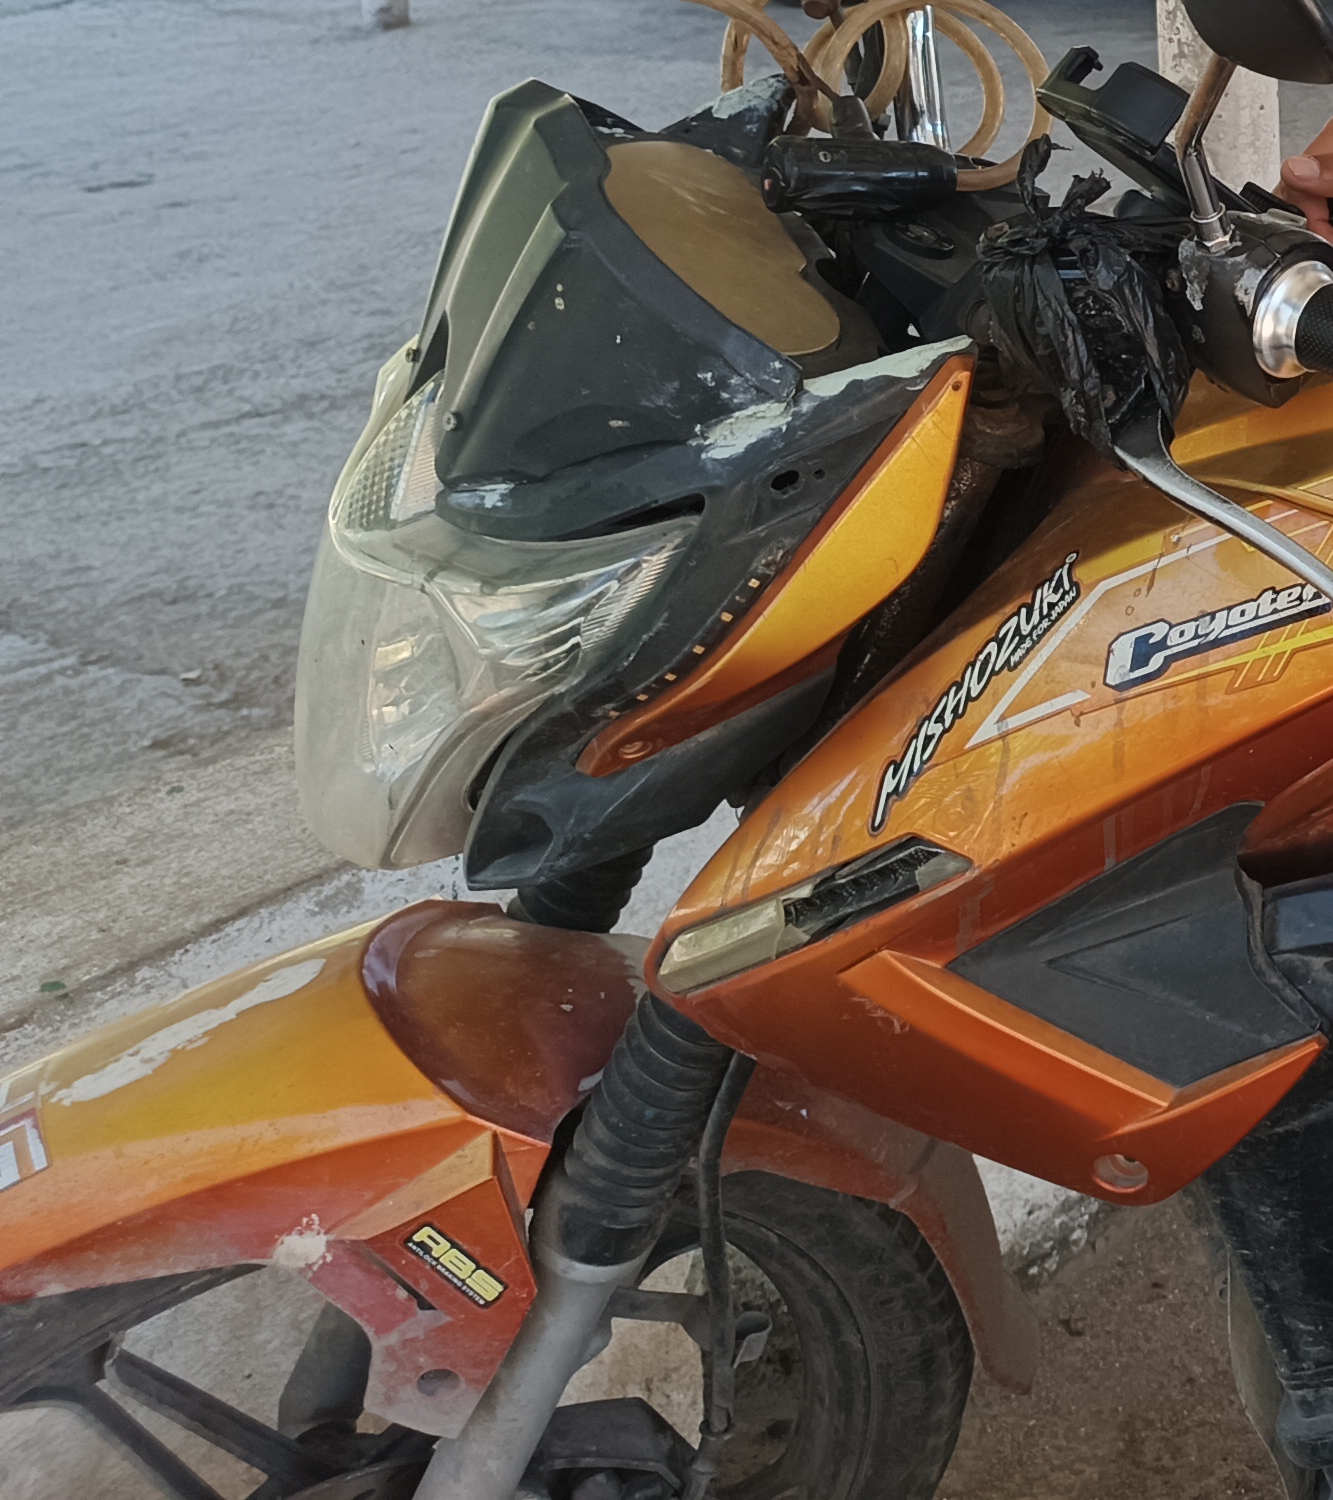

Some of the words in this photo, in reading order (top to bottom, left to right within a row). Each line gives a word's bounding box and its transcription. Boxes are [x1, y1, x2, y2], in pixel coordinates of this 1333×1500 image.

[1010, 634, 1033, 667] MADE
[1031, 618, 1051, 643] FOR
[1048, 585, 1077, 628] JAPAN
[411, 1225, 504, 1302] ABS
[436, 1264, 463, 1288] BRAKING
[461, 1285, 486, 1306] SYSTEM
